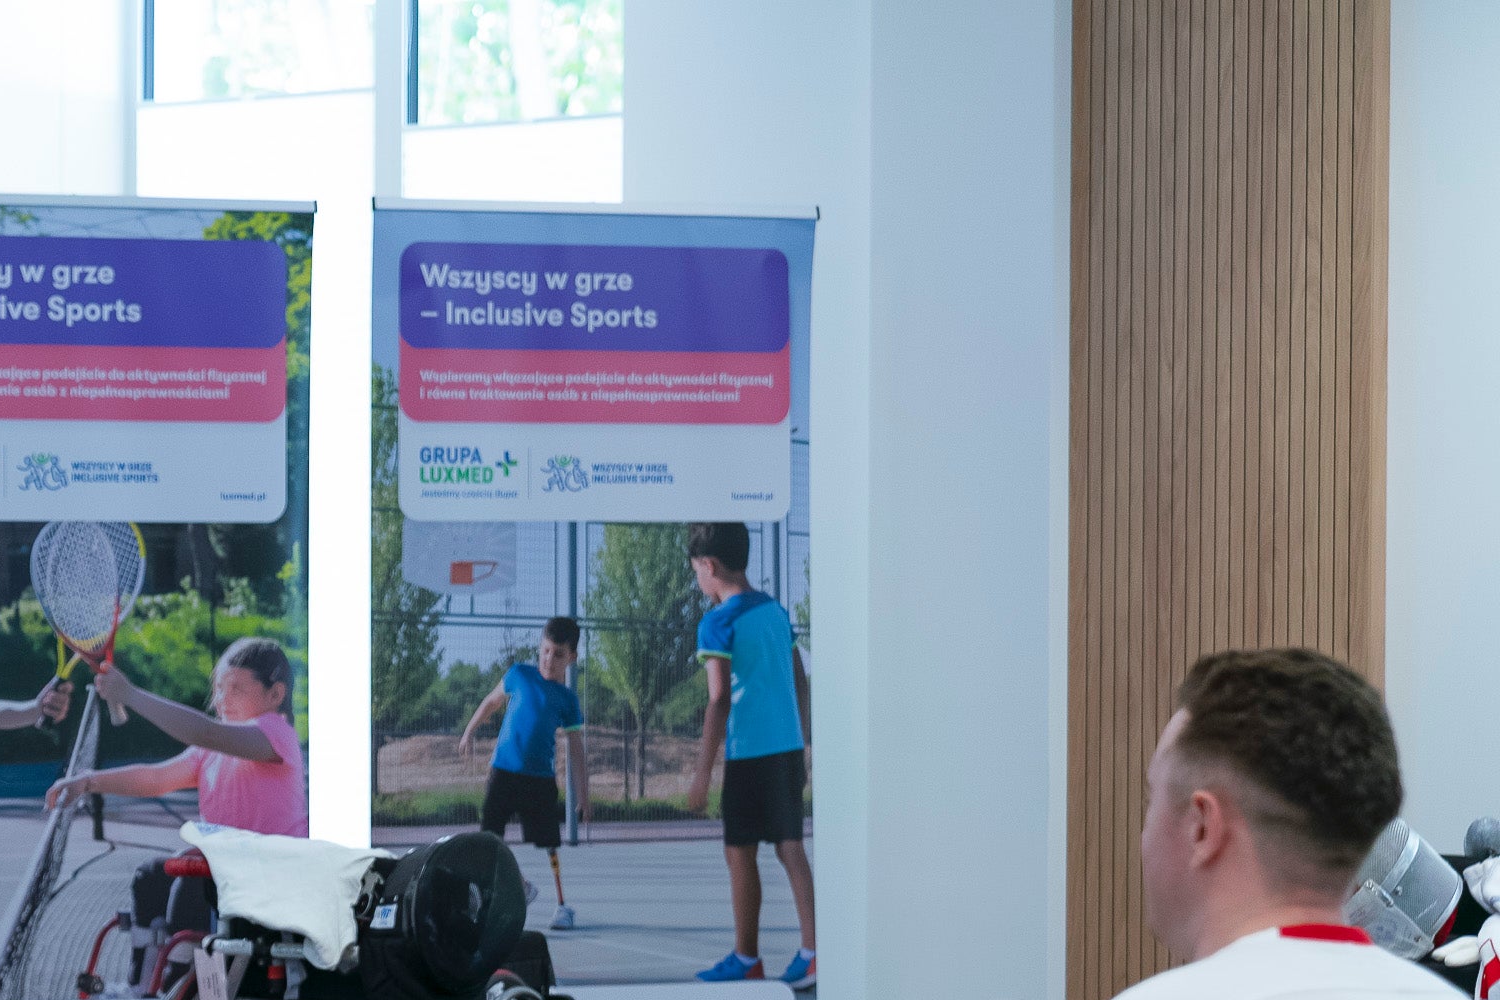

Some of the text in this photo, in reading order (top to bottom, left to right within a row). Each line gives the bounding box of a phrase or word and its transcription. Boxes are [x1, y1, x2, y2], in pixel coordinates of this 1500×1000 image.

[20, 264, 46, 283] w
[51, 264, 116, 290] grze
[419, 263, 634, 297] Wszyscy w grze
[47, 294, 143, 328] Sports
[446, 301, 565, 327] Inclusive
[570, 302, 658, 334] Sports
[108, 368, 125, 381] do
[208, 368, 267, 385] fizycznej
[627, 372, 642, 385] do
[23, 384, 57, 397] osób
[469, 388, 544, 400] traktowanie
[547, 388, 579, 400] osób
[419, 447, 482, 465] GRUPA
[71, 461, 152, 472] WSZYSCY W GRZE
[591, 463, 668, 473] WSZYSCY W GRZE
[71, 473, 159, 483] INCLUSIVE SPORTS
[419, 466, 494, 484] LUXMED
[591, 474, 674, 485] INCLUSIVE SPORTS
